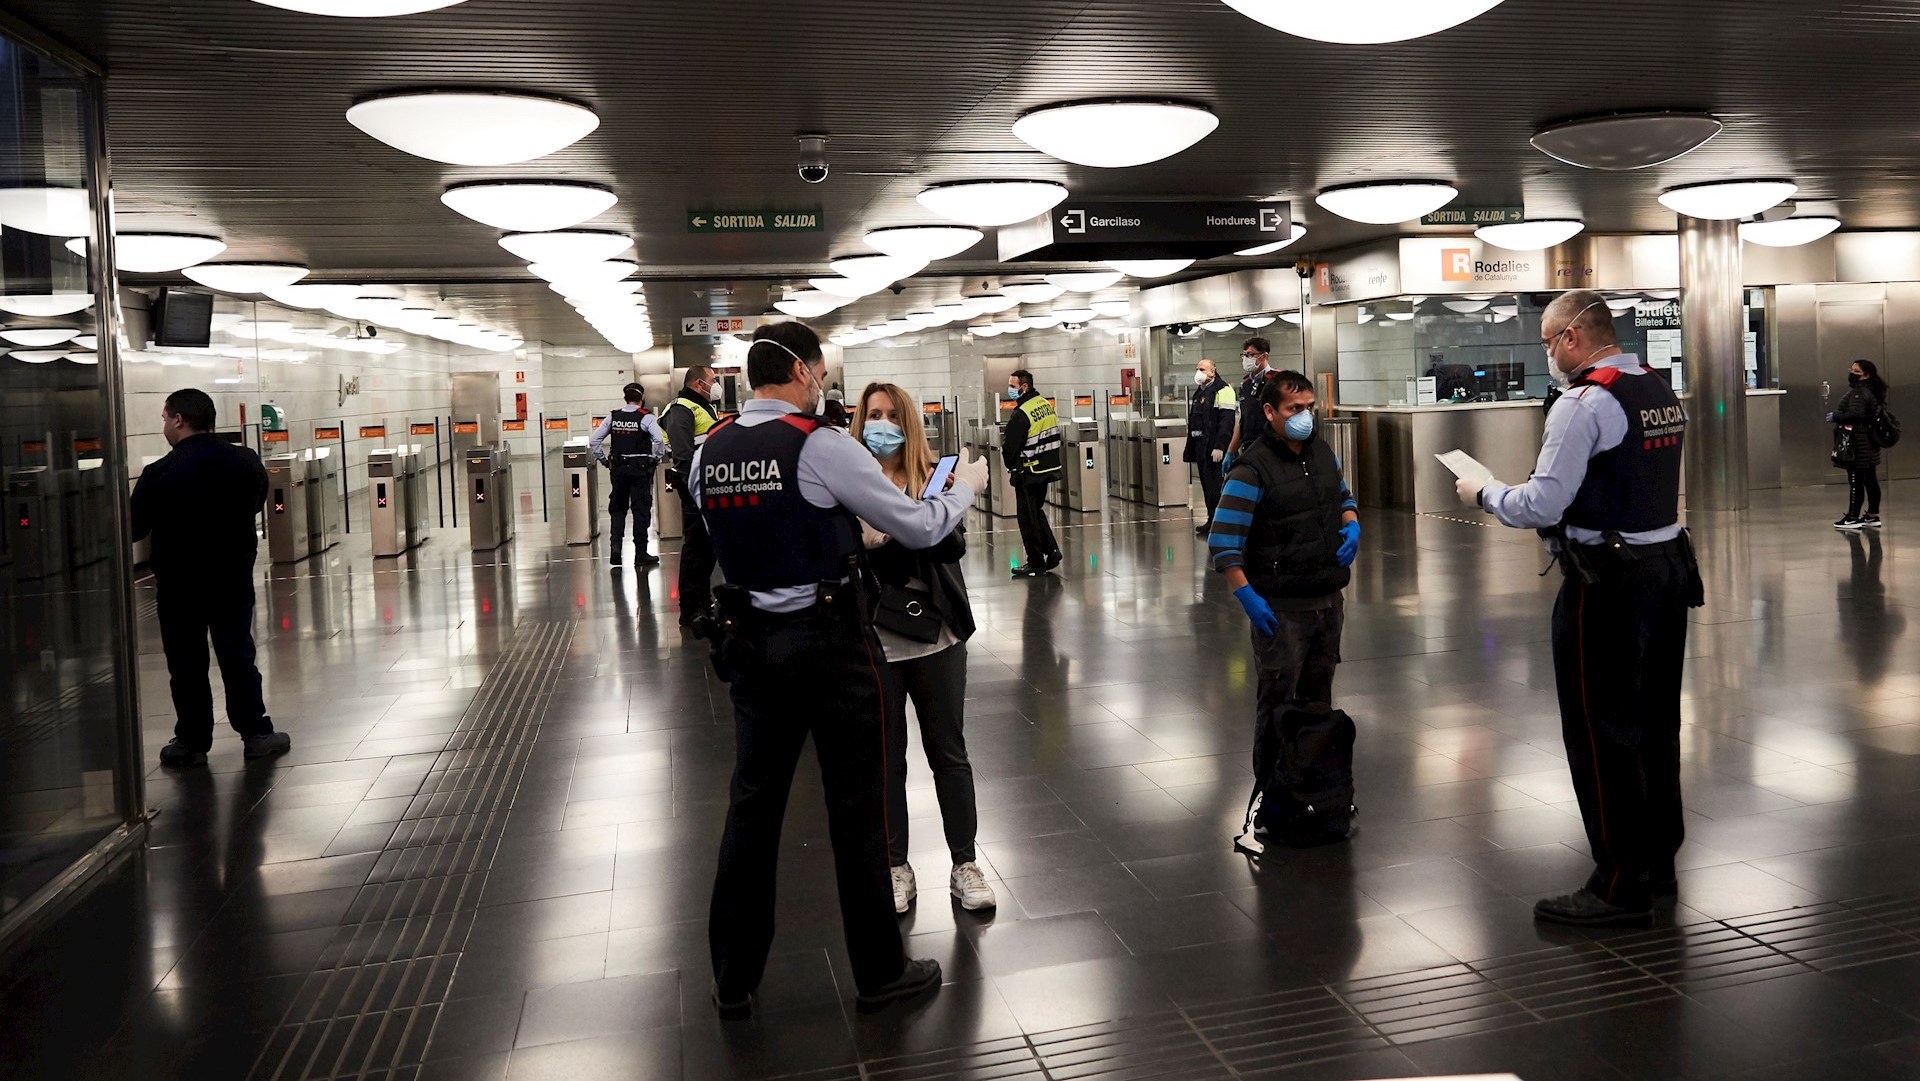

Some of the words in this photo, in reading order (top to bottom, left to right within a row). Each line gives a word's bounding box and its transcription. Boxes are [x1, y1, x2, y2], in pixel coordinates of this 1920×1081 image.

[713, 215, 765, 228] SORTIDA
[774, 214, 817, 227] SALIDA
[1090, 216, 1141, 227] Garcilaso
[1206, 215, 1256, 226] Hondures
[1428, 211, 1466, 222] SORTIDA
[1473, 210, 1505, 222] SALIDA
[1452, 253, 1471, 274] R
[1475, 261, 1530, 273] Rodalies
[1321, 267, 1330, 286] R
[1484, 273, 1518, 283] Catalunya
[718, 321, 729, 330] R3
[731, 320, 742, 330] R4
[1635, 318, 1664, 327] Billetes
[1640, 405, 1683, 427] POLICIA
[612, 420, 638, 429] POLICIA
[705, 460, 781, 484] POLICIA
[705, 485, 734, 495] mossos
